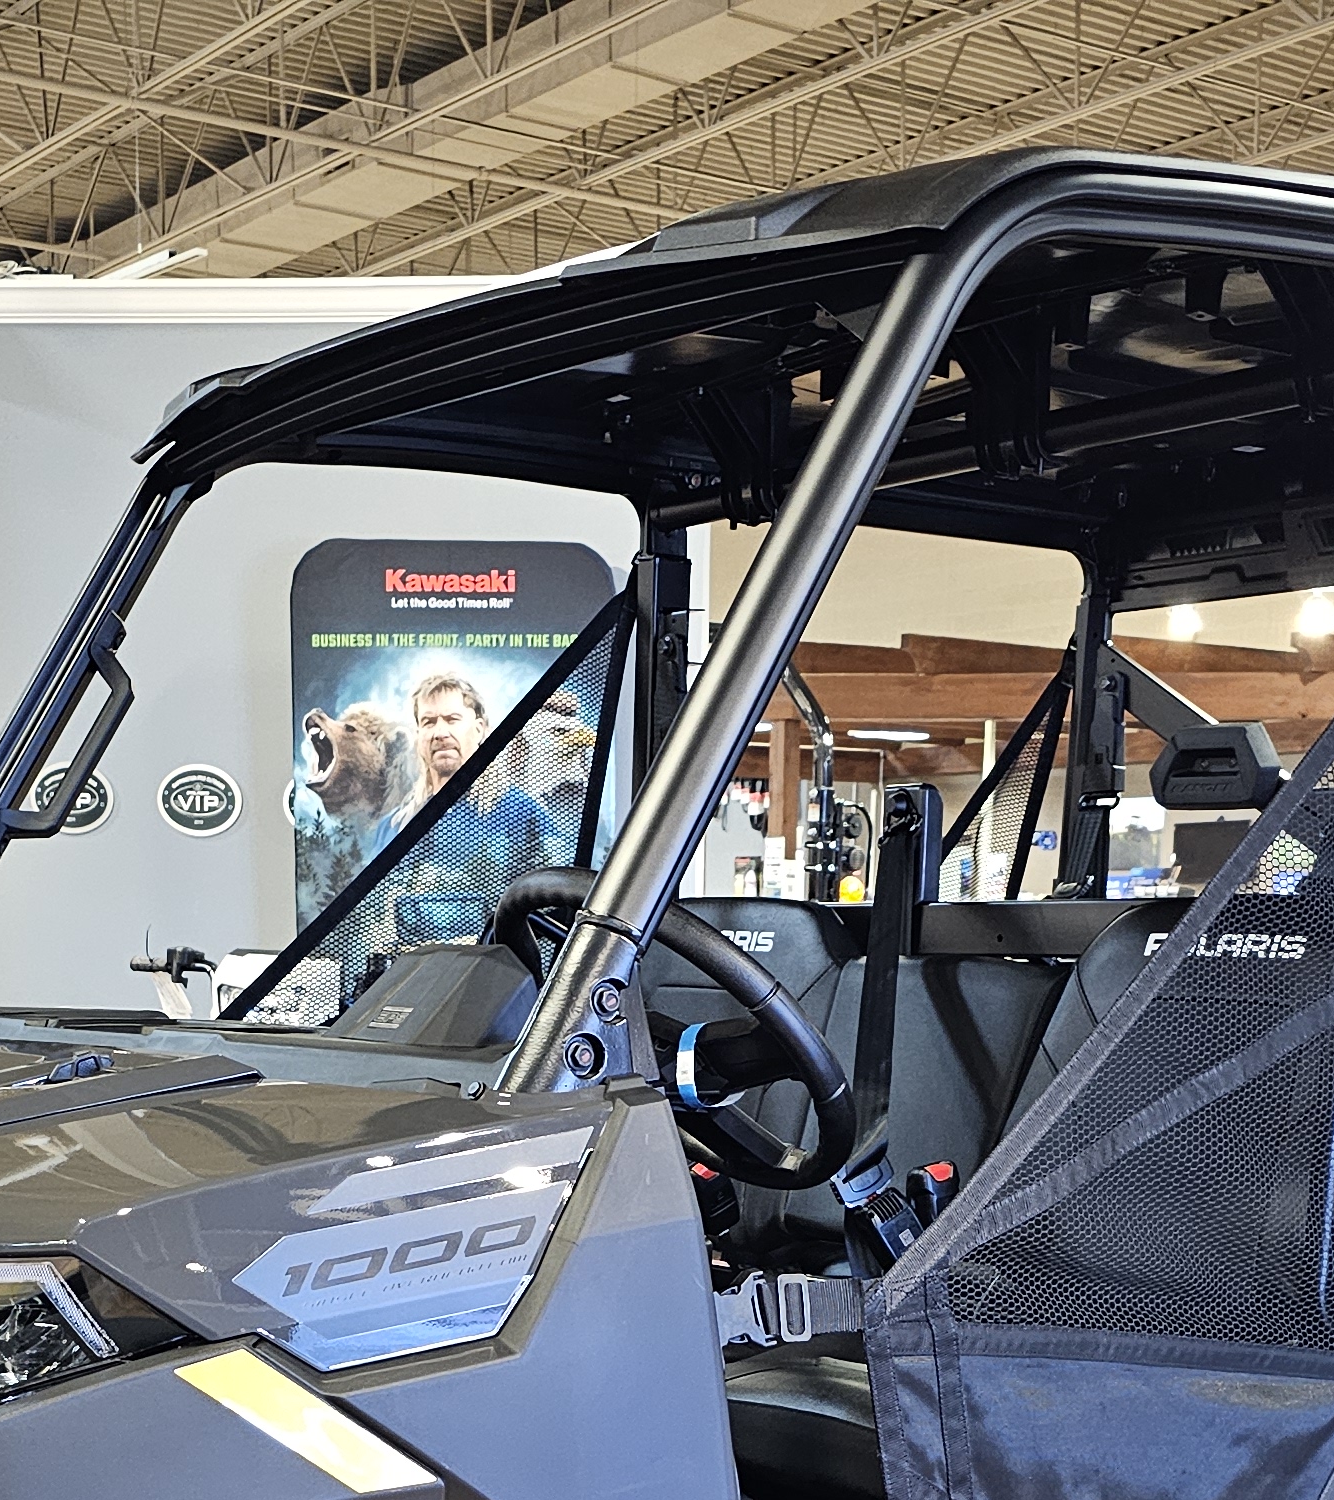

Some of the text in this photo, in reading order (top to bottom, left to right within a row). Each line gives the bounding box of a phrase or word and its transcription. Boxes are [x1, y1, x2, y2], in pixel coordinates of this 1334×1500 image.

[385, 568, 516, 594] Kawasaki
[391, 597, 409, 609] Let
[410, 597, 427, 609] the
[428, 597, 456, 609] Good
[457, 597, 488, 609] Times
[311, 633, 373, 648] BUSINESS
[376, 633, 391, 647] IN
[392, 633, 416, 648] THE
[466, 633, 506, 648] PARTY
[509, 633, 523, 648] IN
[526, 633, 550, 648] THE
[177, 794, 219, 812] VIP
[1143, 932, 1308, 960] PLARIS
[281, 1214, 537, 1298] 1000
